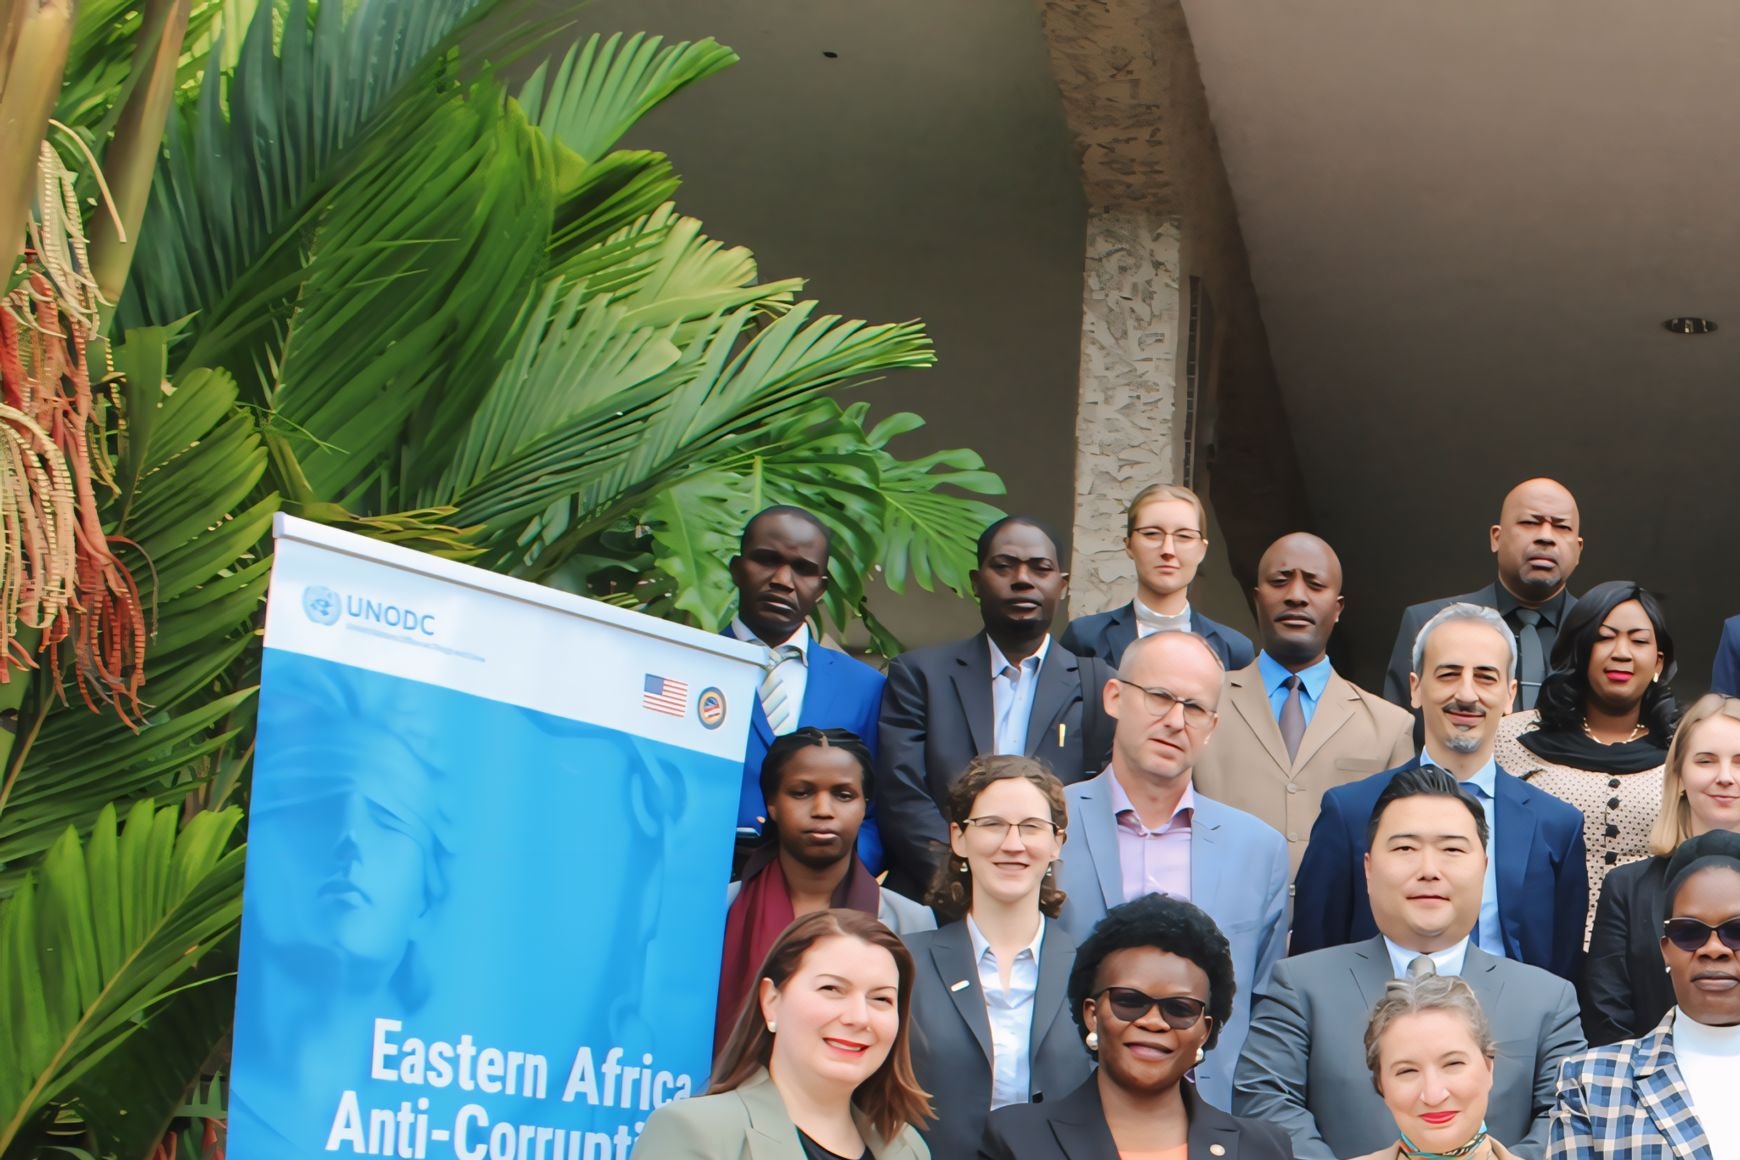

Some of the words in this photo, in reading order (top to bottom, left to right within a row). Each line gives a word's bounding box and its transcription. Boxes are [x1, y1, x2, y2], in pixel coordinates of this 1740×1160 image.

[347, 595, 435, 636] UNODC
[371, 1017, 548, 1099] Eastern
[562, 1046, 692, 1111] Africa
